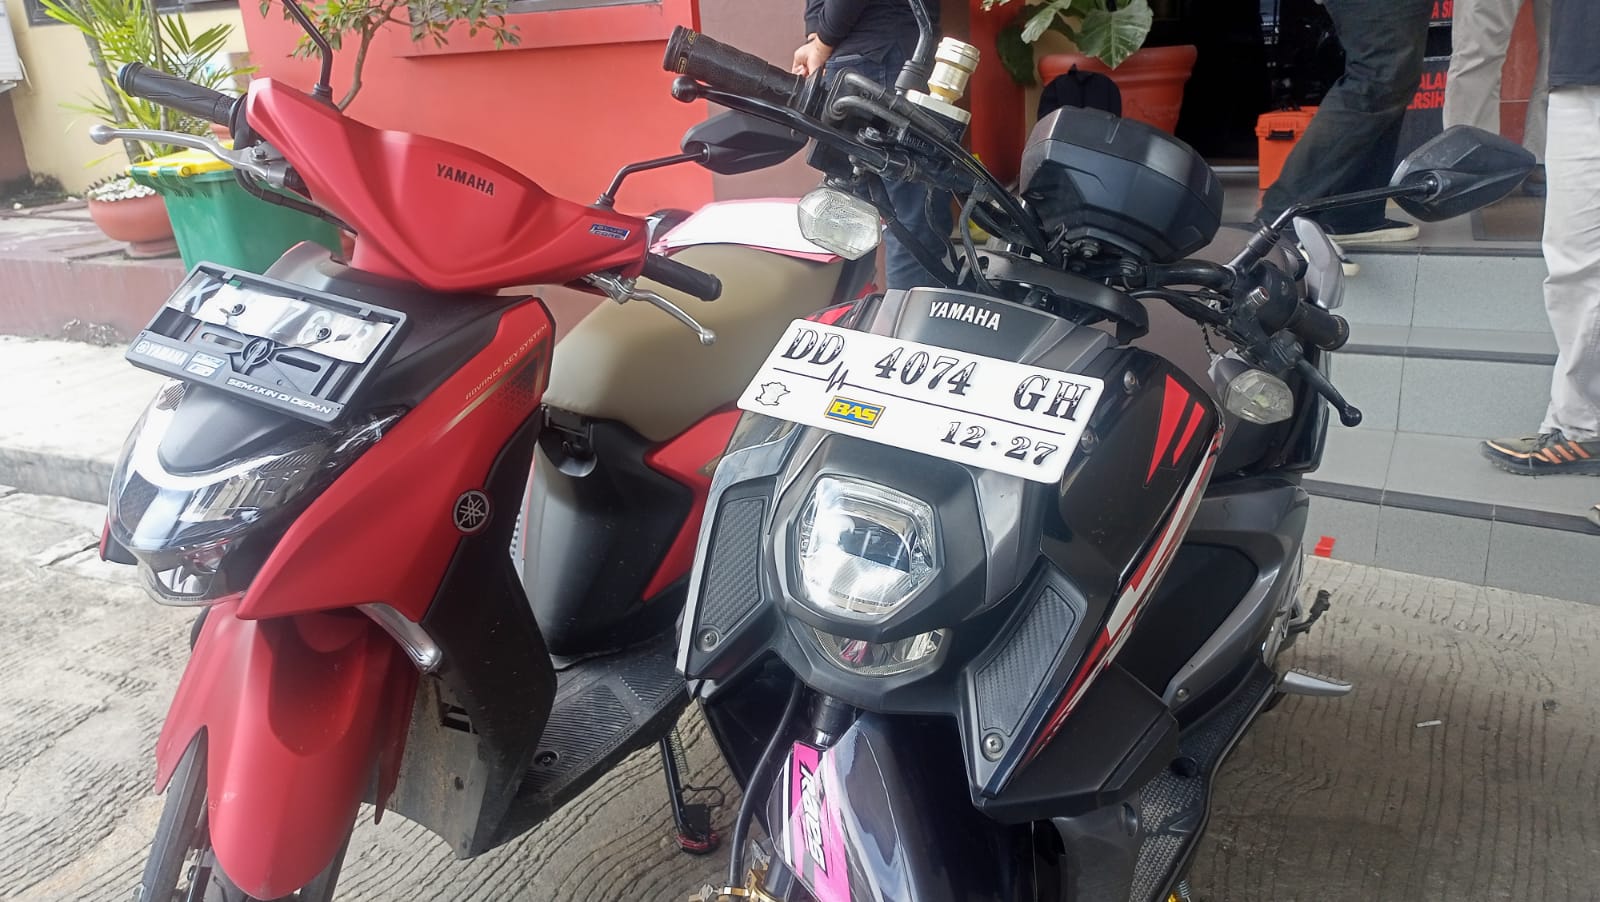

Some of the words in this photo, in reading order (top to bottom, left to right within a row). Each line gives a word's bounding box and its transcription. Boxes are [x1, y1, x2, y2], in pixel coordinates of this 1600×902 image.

[1406, 91, 1445, 110] RSIH
[437, 163, 495, 196] YAMAHA
[929, 301, 1001, 331] YAMAHA
[465, 366, 503, 400] ADVANCE
[503, 351, 519, 369] KEY
[519, 323, 548, 353] SYSTEM
[781, 328, 845, 366] DD
[875, 346, 977, 396] 4074
[1013, 374, 1091, 422] GH
[227, 378, 279, 398] SEMAKIN
[278, 393, 291, 402] DI
[290, 397, 332, 414] DEPAN
[830, 401, 878, 422] BAS
